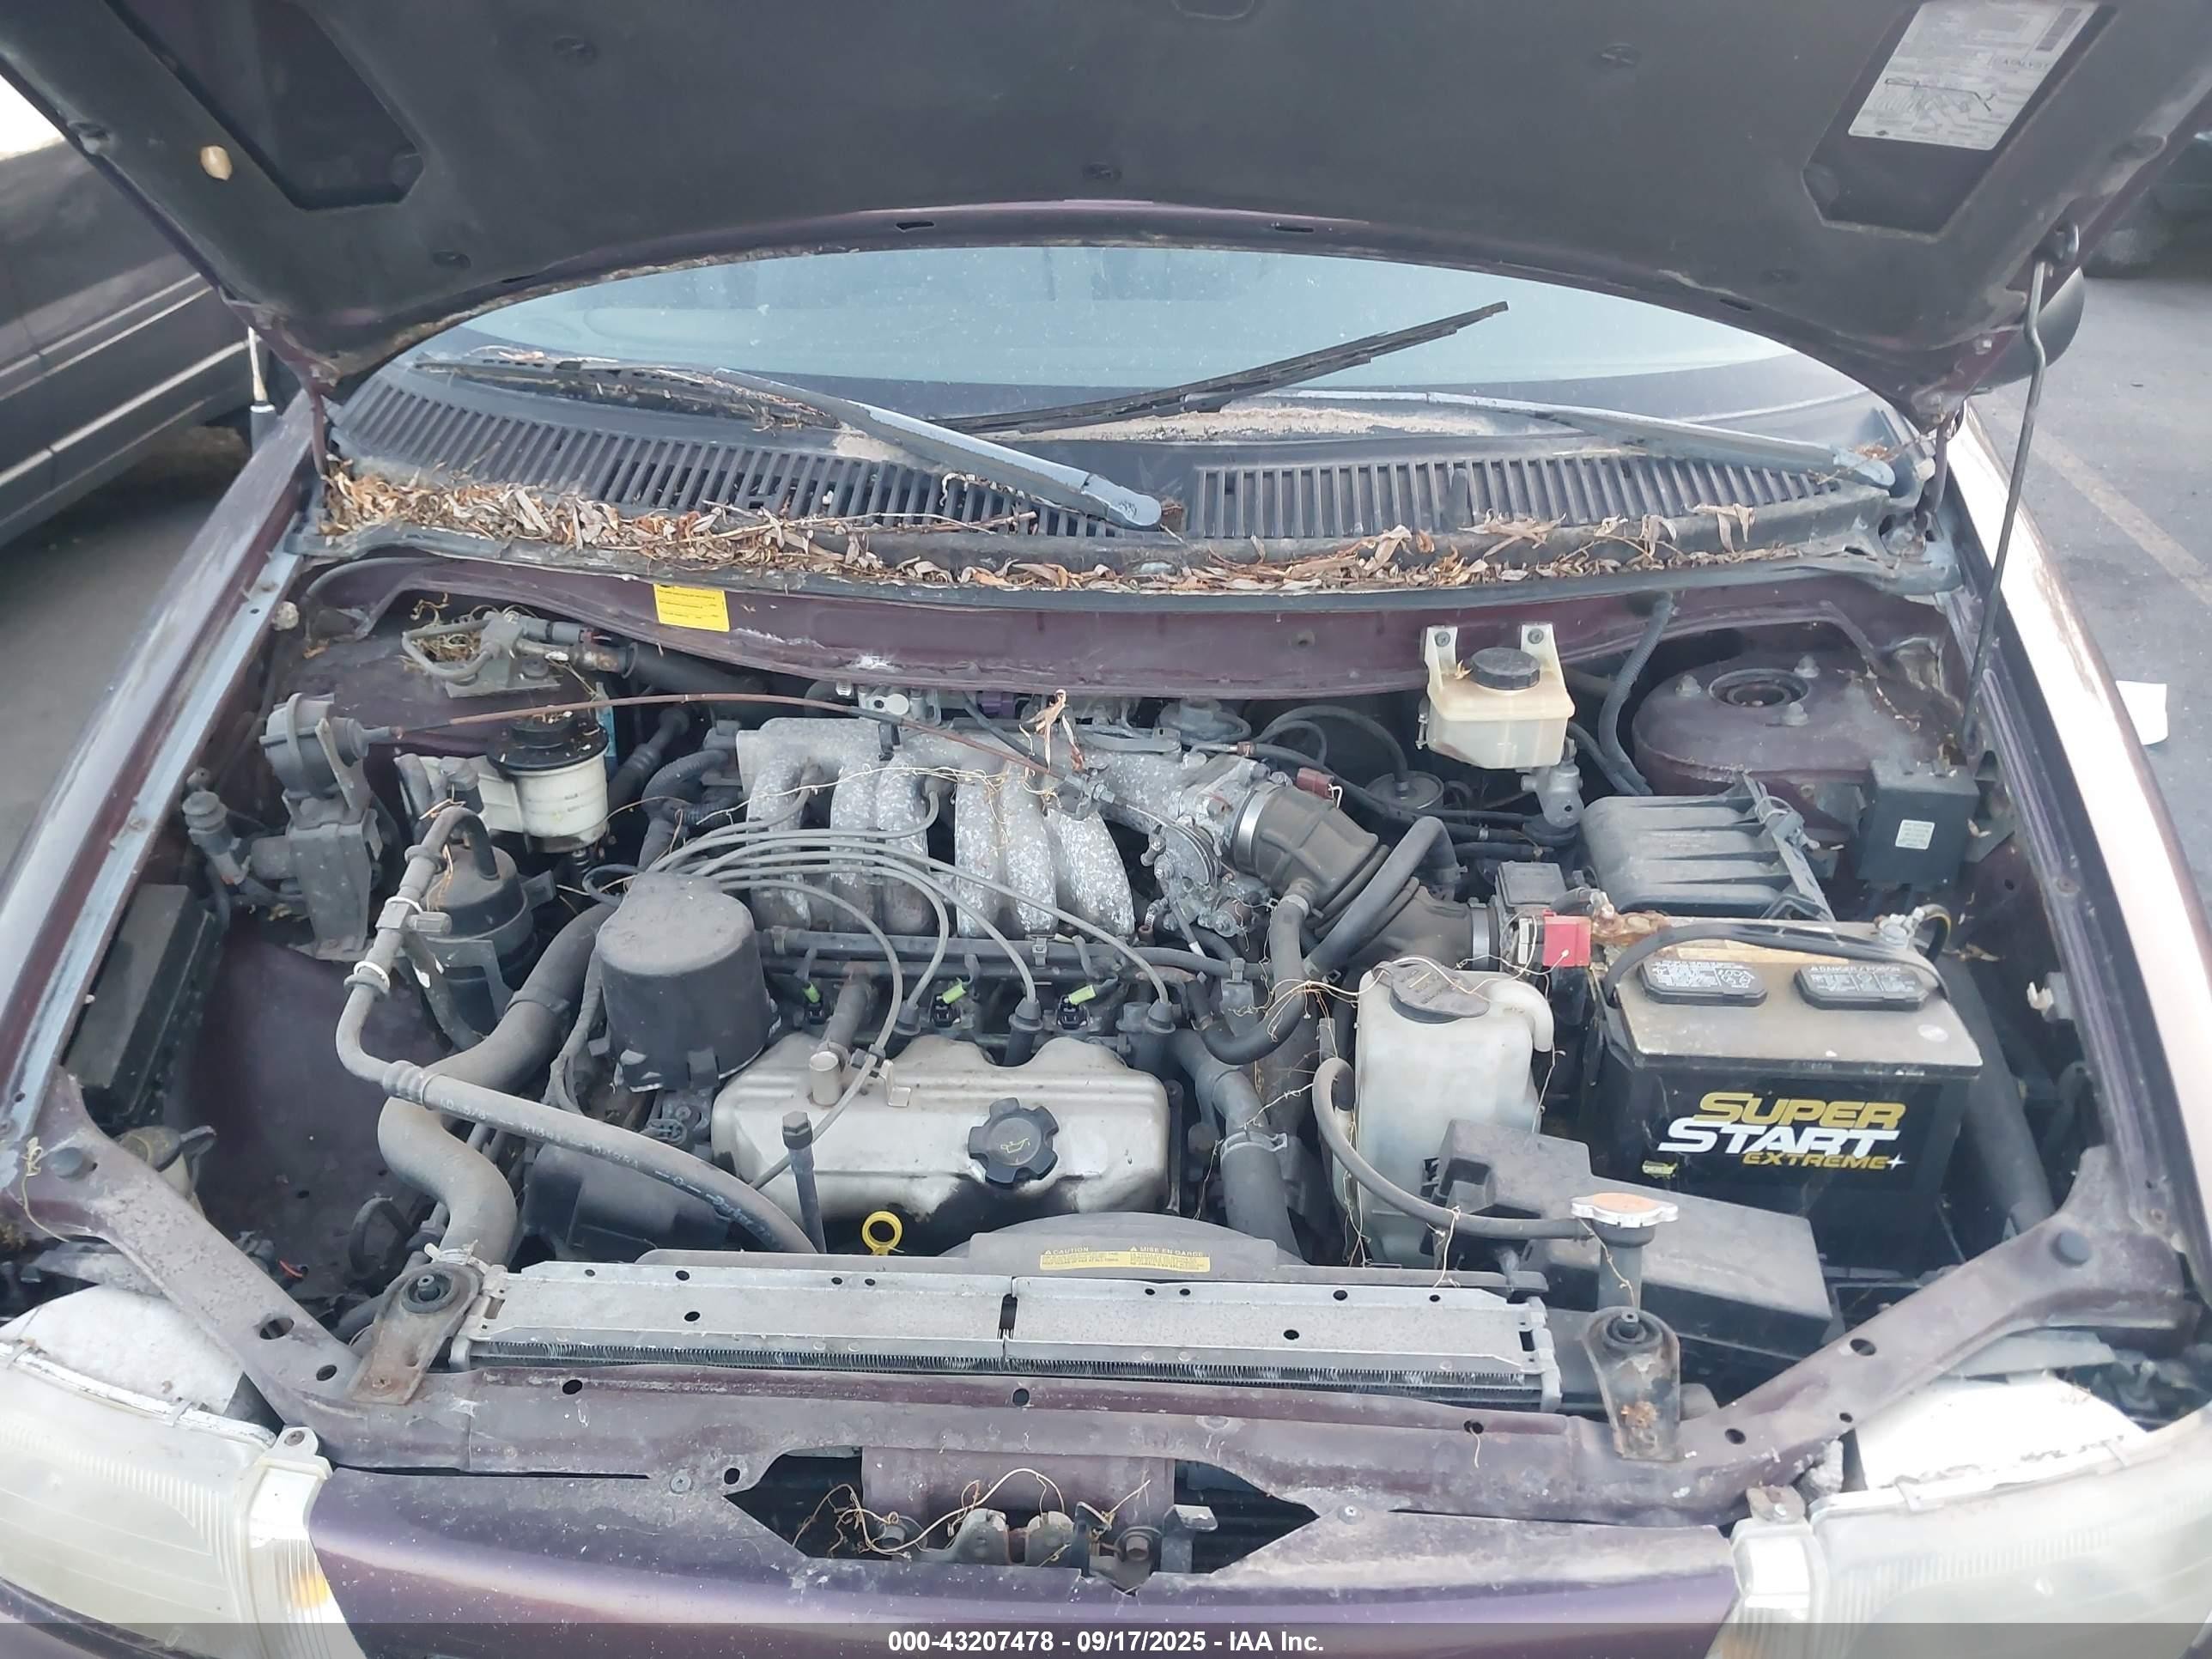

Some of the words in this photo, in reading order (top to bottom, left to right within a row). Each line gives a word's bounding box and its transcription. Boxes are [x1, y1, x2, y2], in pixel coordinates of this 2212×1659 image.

[1692, 1091, 1906, 1130] SUPER
[1657, 1117, 1900, 1158] START
[1053, 1246, 1089, 1255] CAUTION
